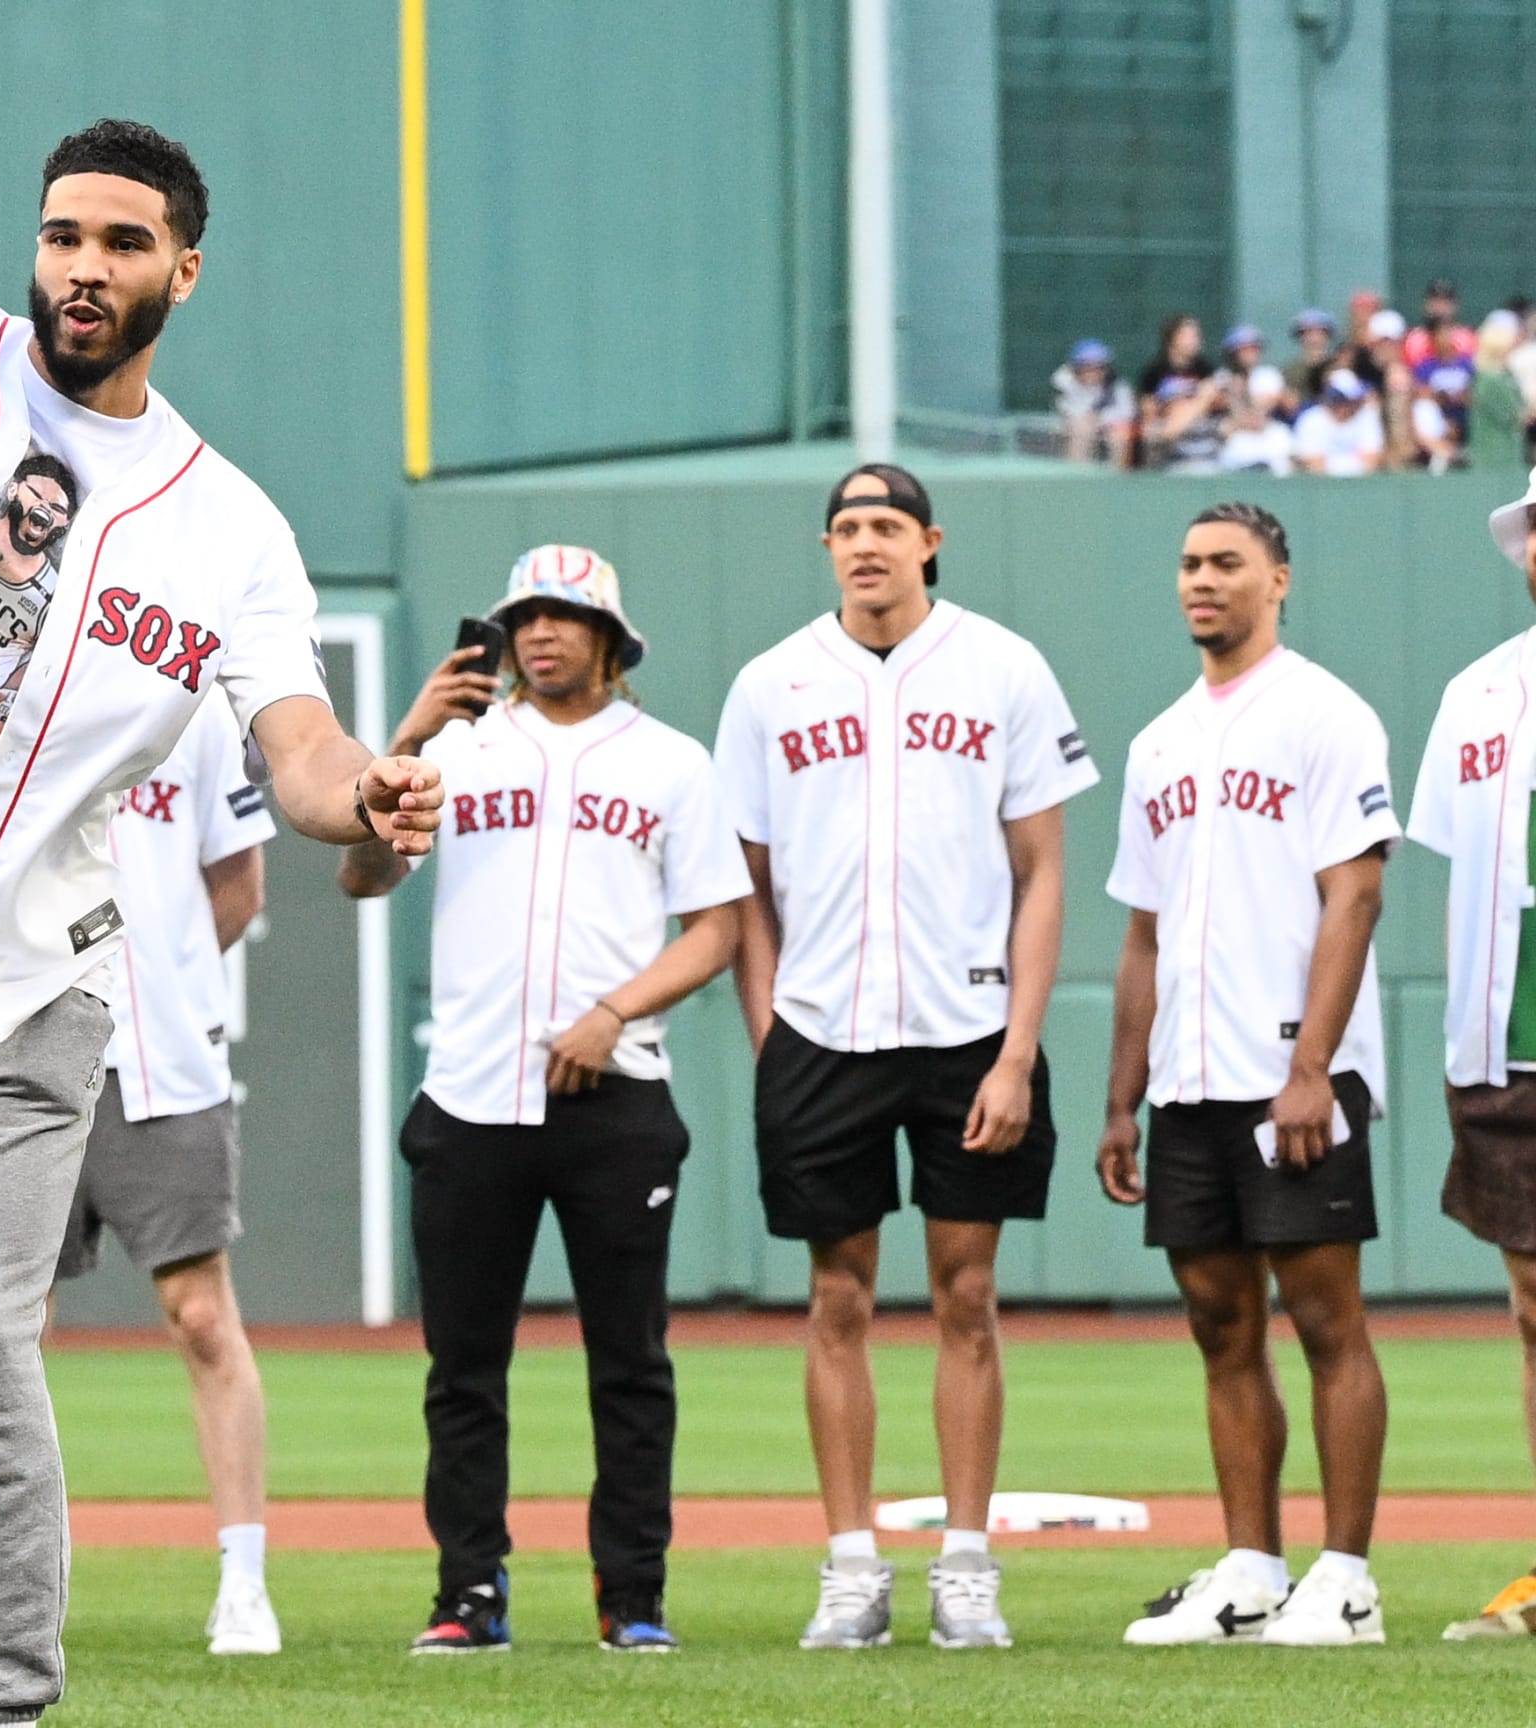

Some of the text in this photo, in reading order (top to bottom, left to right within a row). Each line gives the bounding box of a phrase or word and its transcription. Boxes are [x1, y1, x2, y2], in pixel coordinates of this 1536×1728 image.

[88, 586, 221, 694] SOX
[781, 712, 996, 772] RED SOX
[453, 788, 662, 850] RED SOX
[1147, 768, 1295, 838] RED SOX
